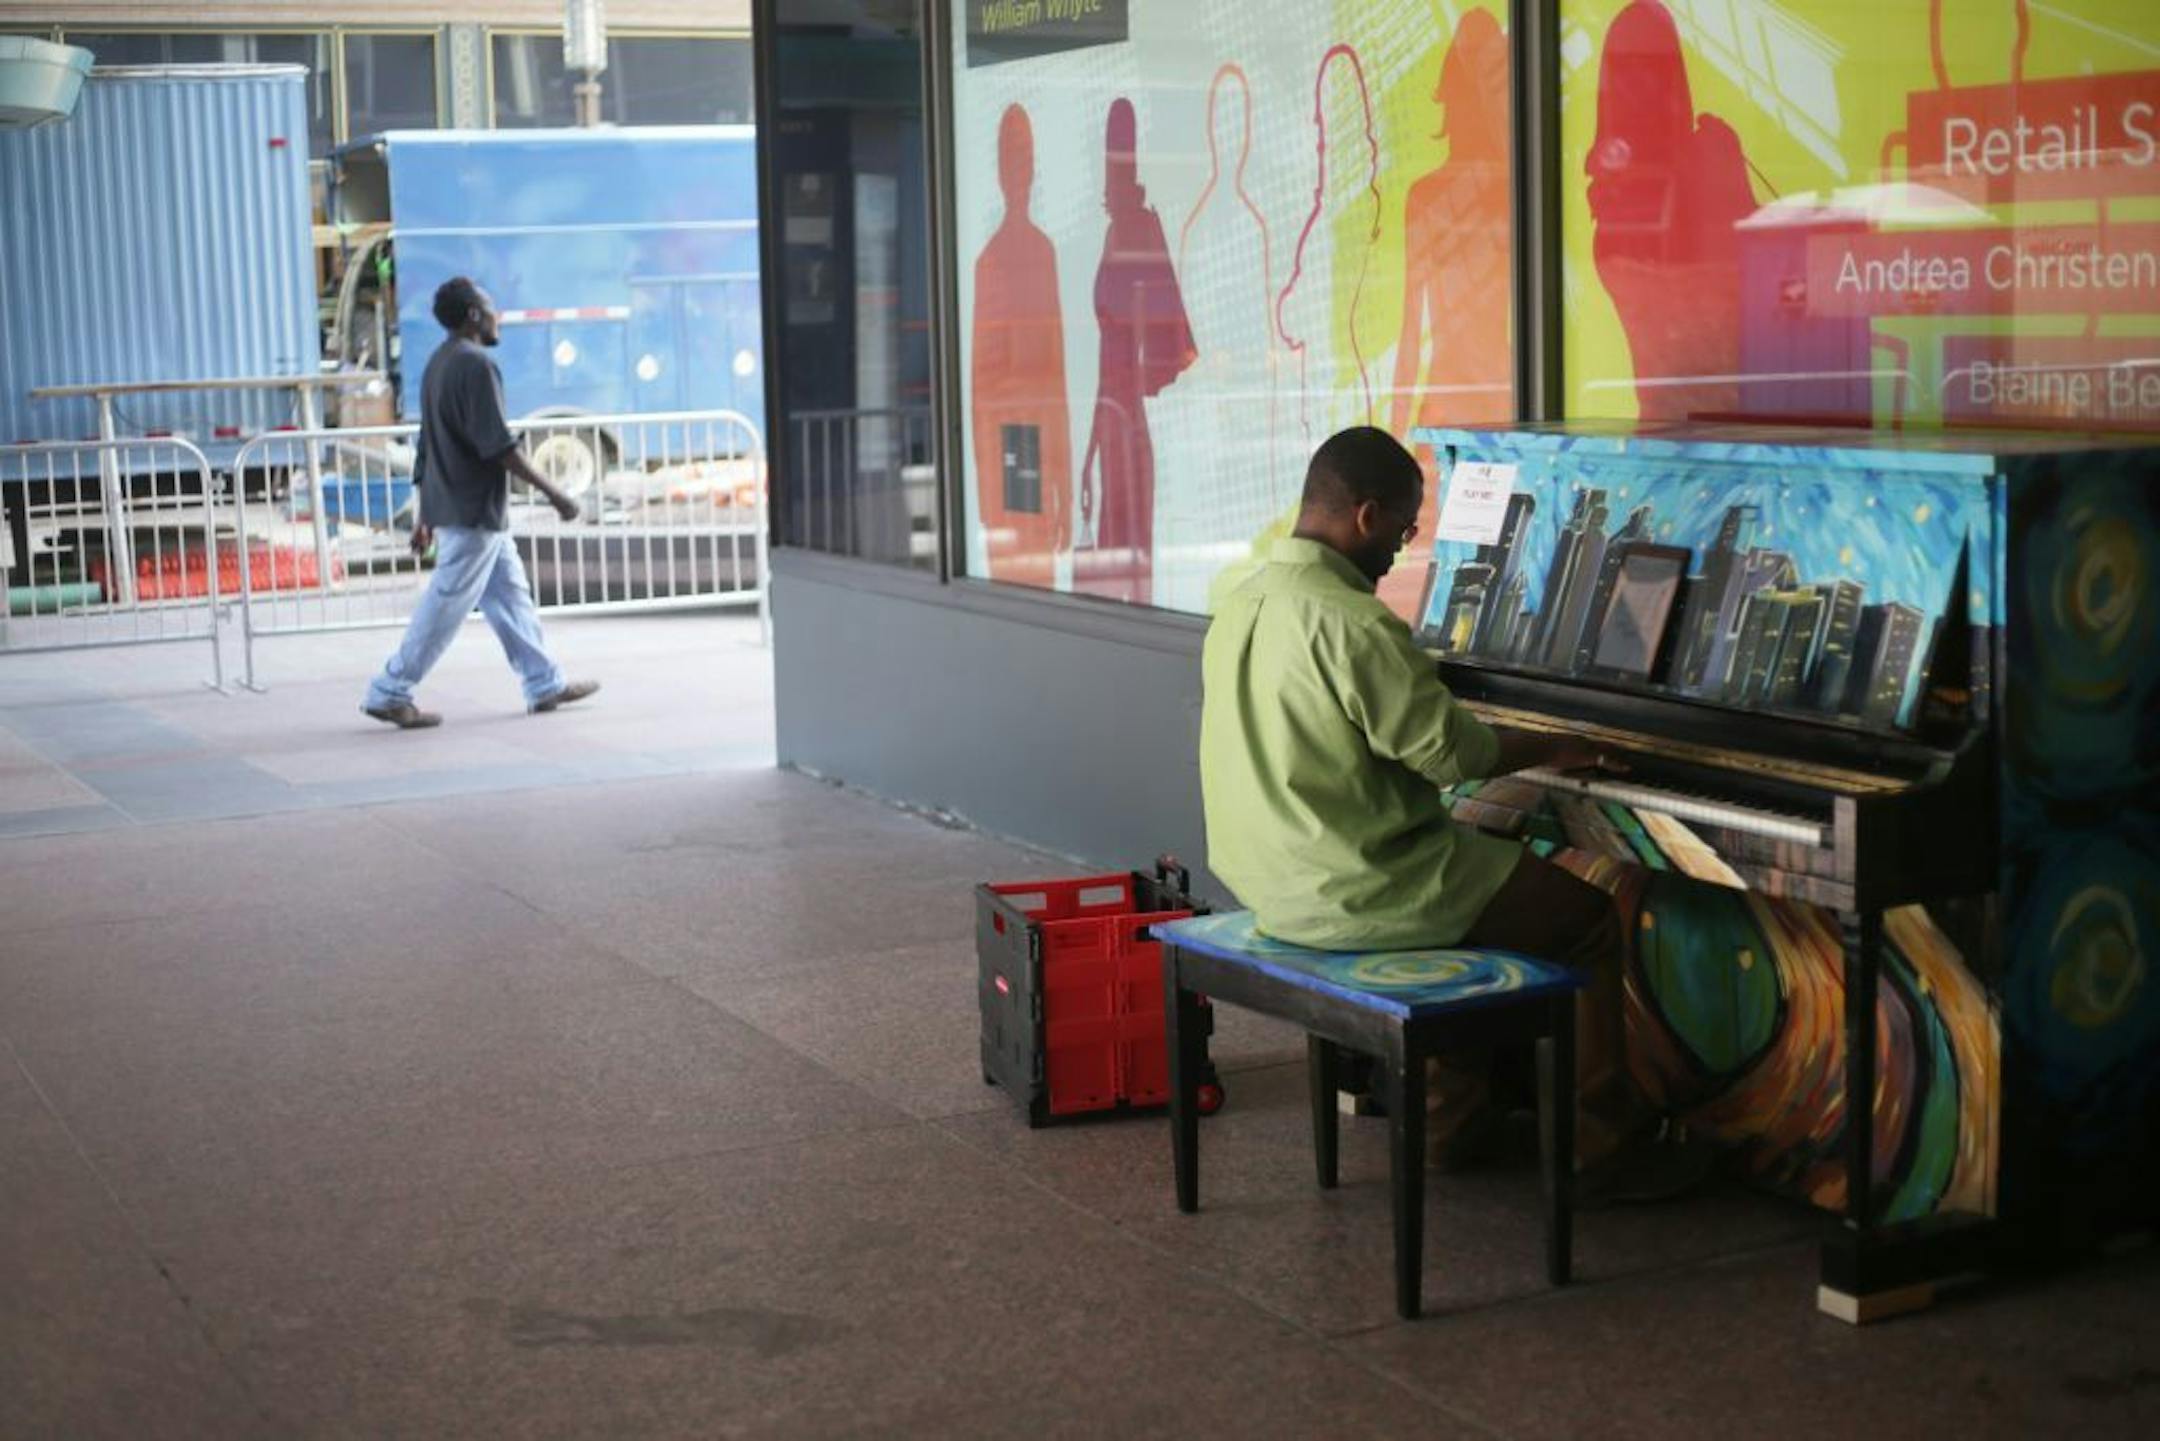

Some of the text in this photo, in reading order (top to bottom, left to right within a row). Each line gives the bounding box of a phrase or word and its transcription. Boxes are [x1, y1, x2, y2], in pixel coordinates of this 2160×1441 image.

[1943, 104, 2098, 176] Retail
[1835, 248, 1971, 294] Andrea
[1969, 360, 2091, 407] Blaine
